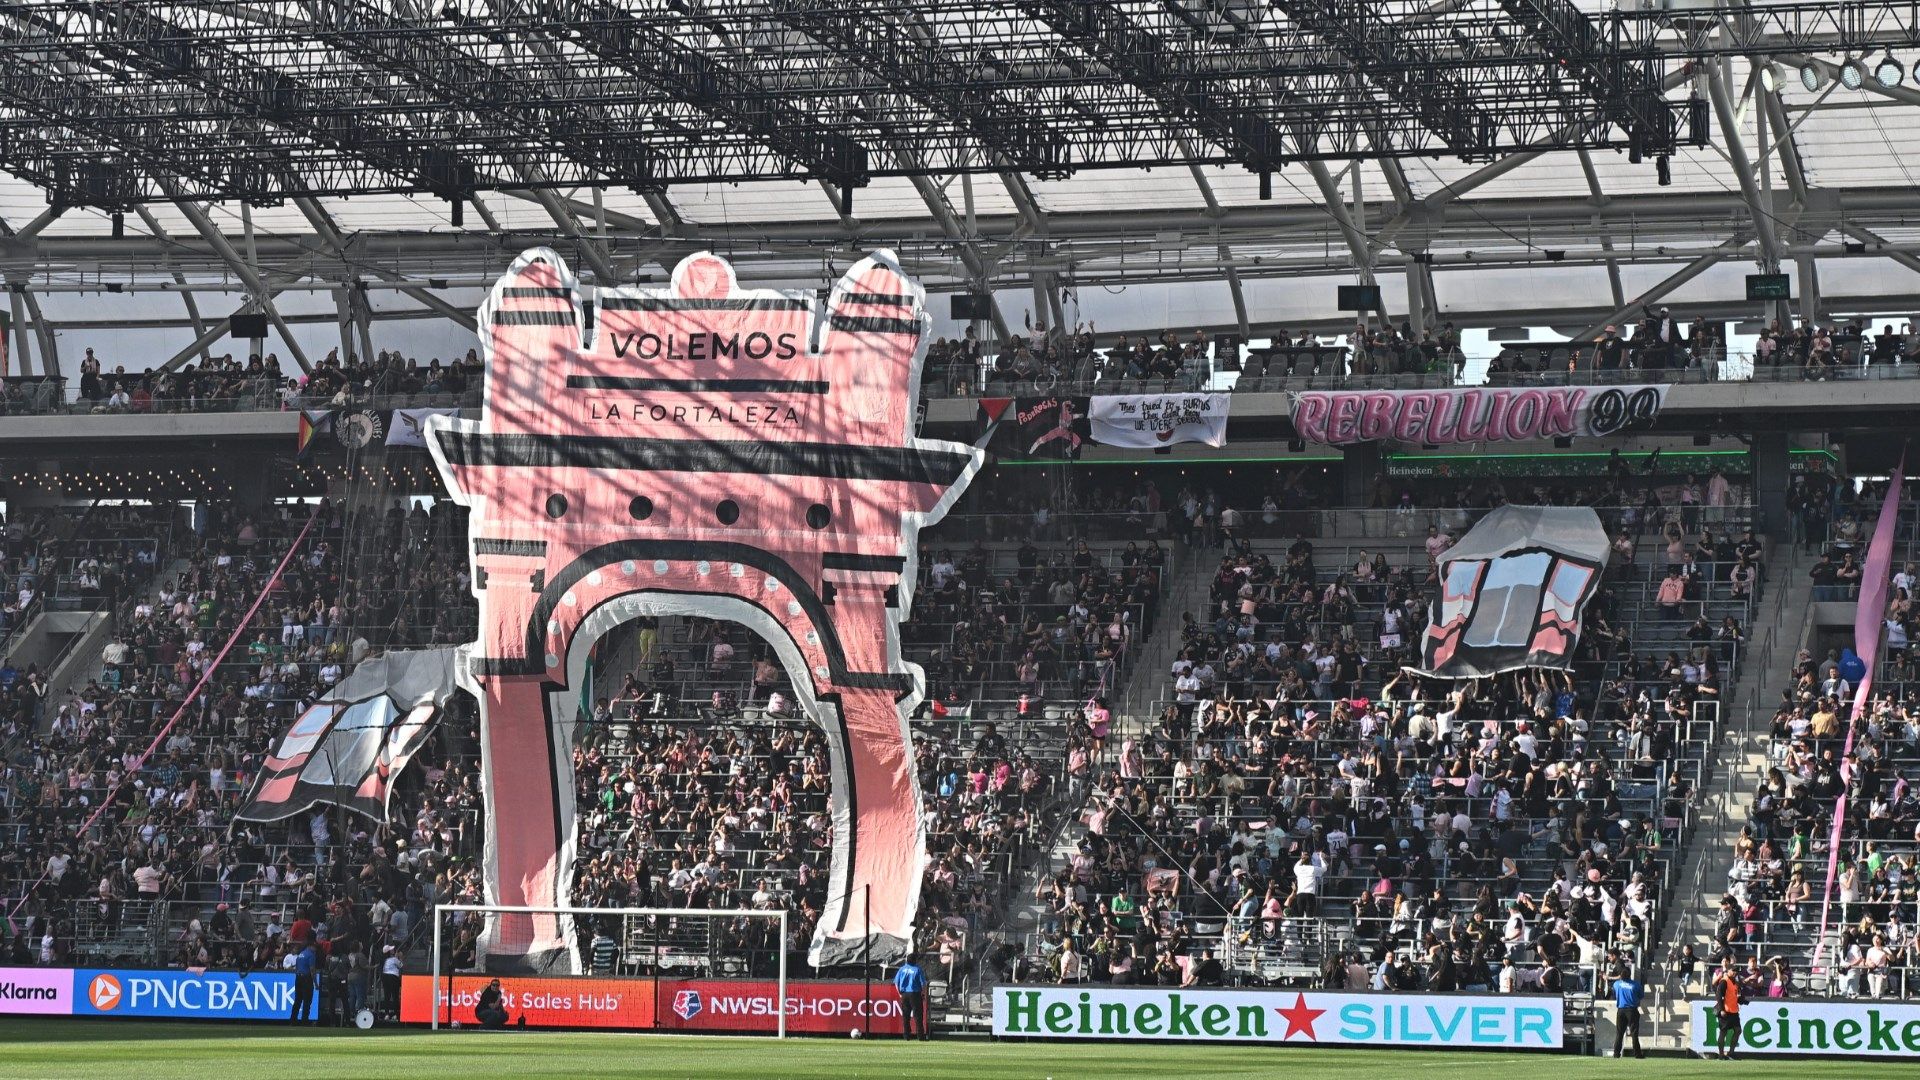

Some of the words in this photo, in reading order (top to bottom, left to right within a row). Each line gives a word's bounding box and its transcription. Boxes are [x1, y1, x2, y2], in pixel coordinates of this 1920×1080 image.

[610, 331, 797, 360] VOLEMOS
[592, 403, 621, 420] LA
[633, 404, 799, 424] FORTALEZA
[1119, 403, 1136, 414] They
[1142, 399, 1162, 411] tried
[1295, 388, 1586, 443] REBELLION
[1135, 420, 1145, 430] WE
[1388, 466, 1433, 476] Heineken
[0, 982, 57, 1001] Klarna
[128, 978, 202, 1010] PNC
[205, 980, 302, 1011] BANK
[438, 988, 515, 1009] HubSot
[522, 992, 572, 1009] Sales
[1005, 991, 1268, 1037] Heineken
[1339, 1003, 1553, 1044] SILVER
